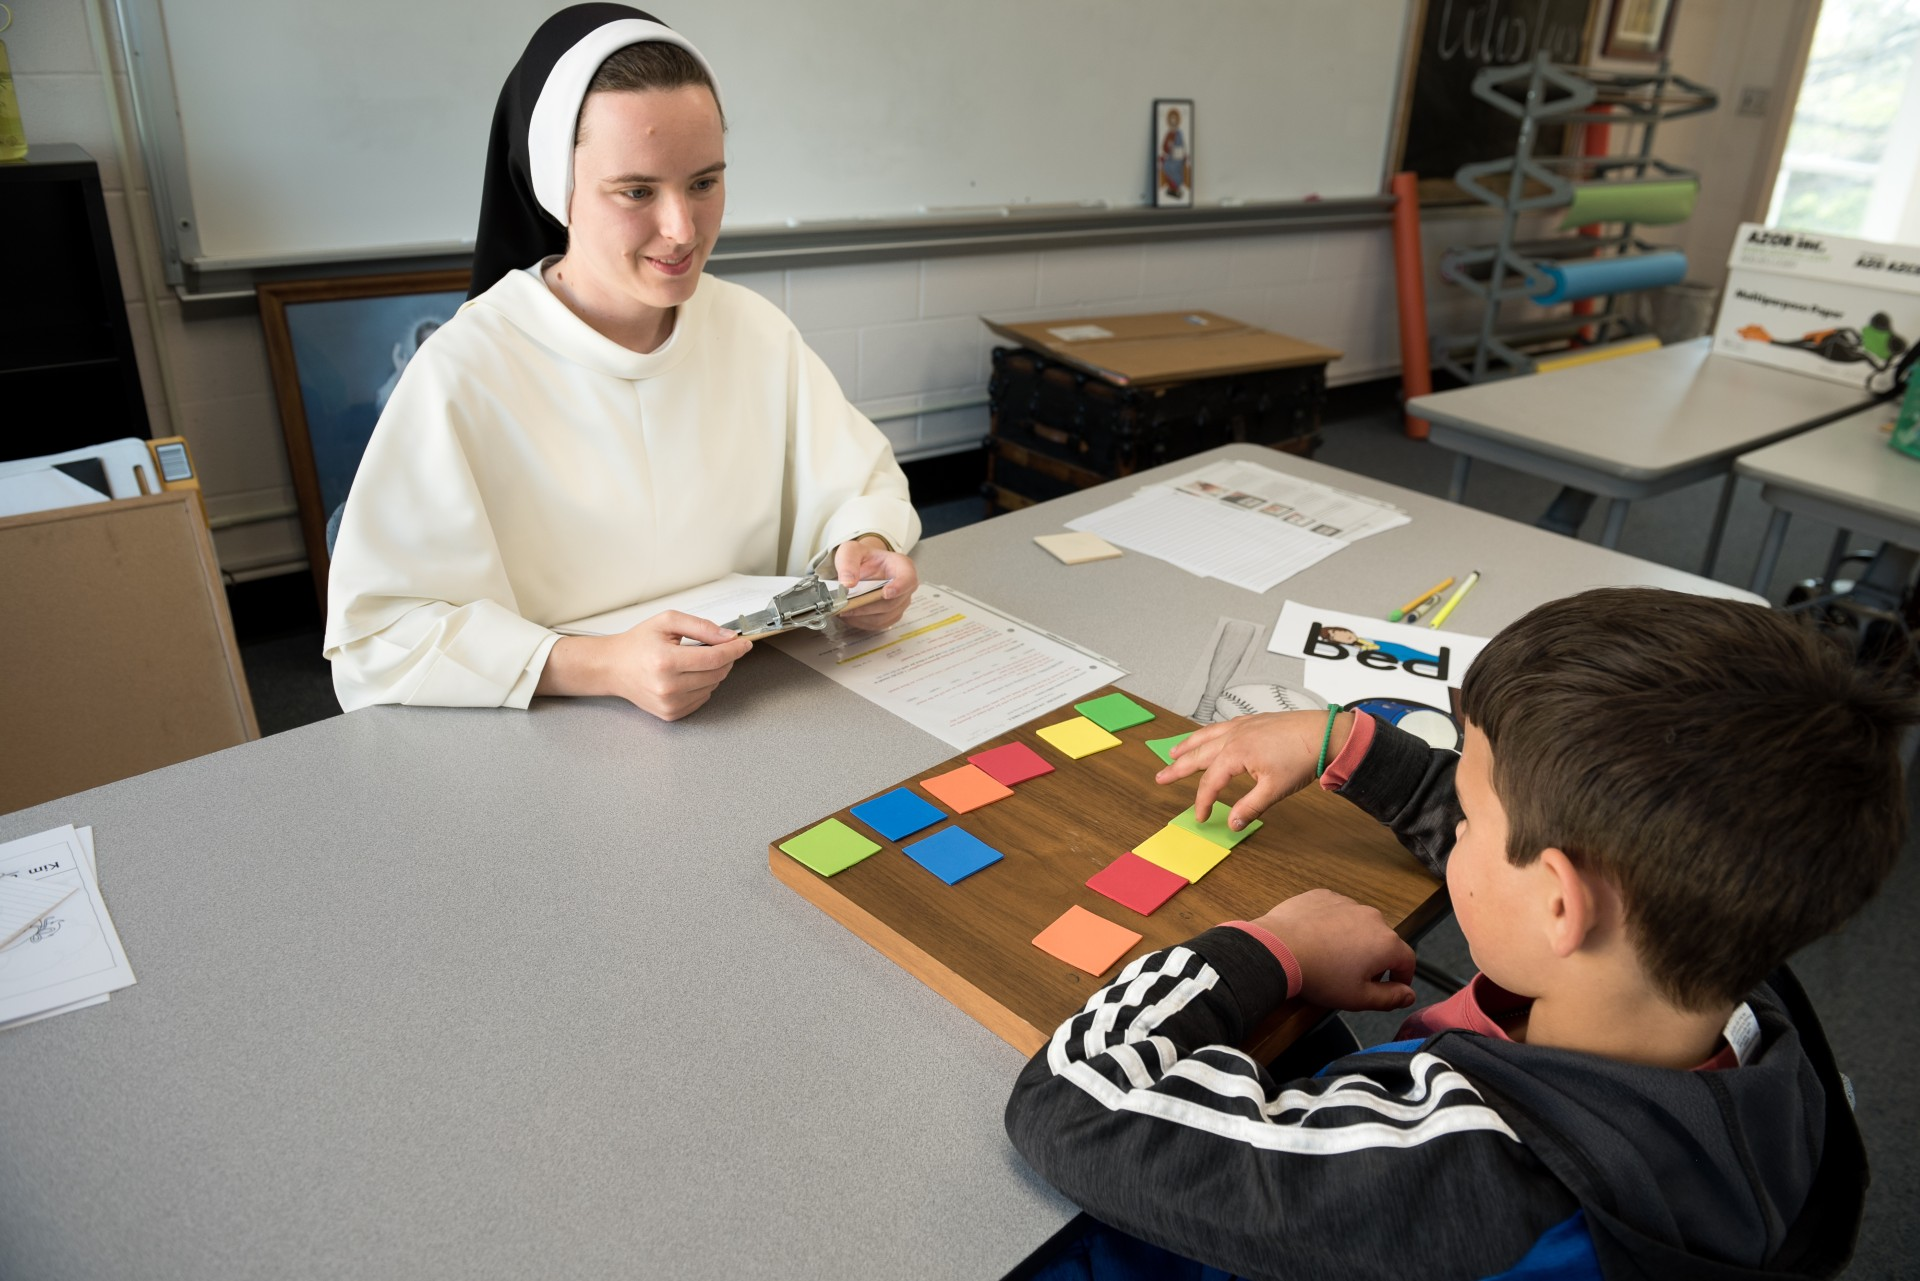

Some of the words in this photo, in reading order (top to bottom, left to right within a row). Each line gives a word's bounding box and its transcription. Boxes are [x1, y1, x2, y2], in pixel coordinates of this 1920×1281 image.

[1736, 289, 1807, 311] Multipurpose
[1811, 304, 1845, 320] Paper
[1303, 622, 1451, 681] bed
[28, 861, 60, 875] Kim
